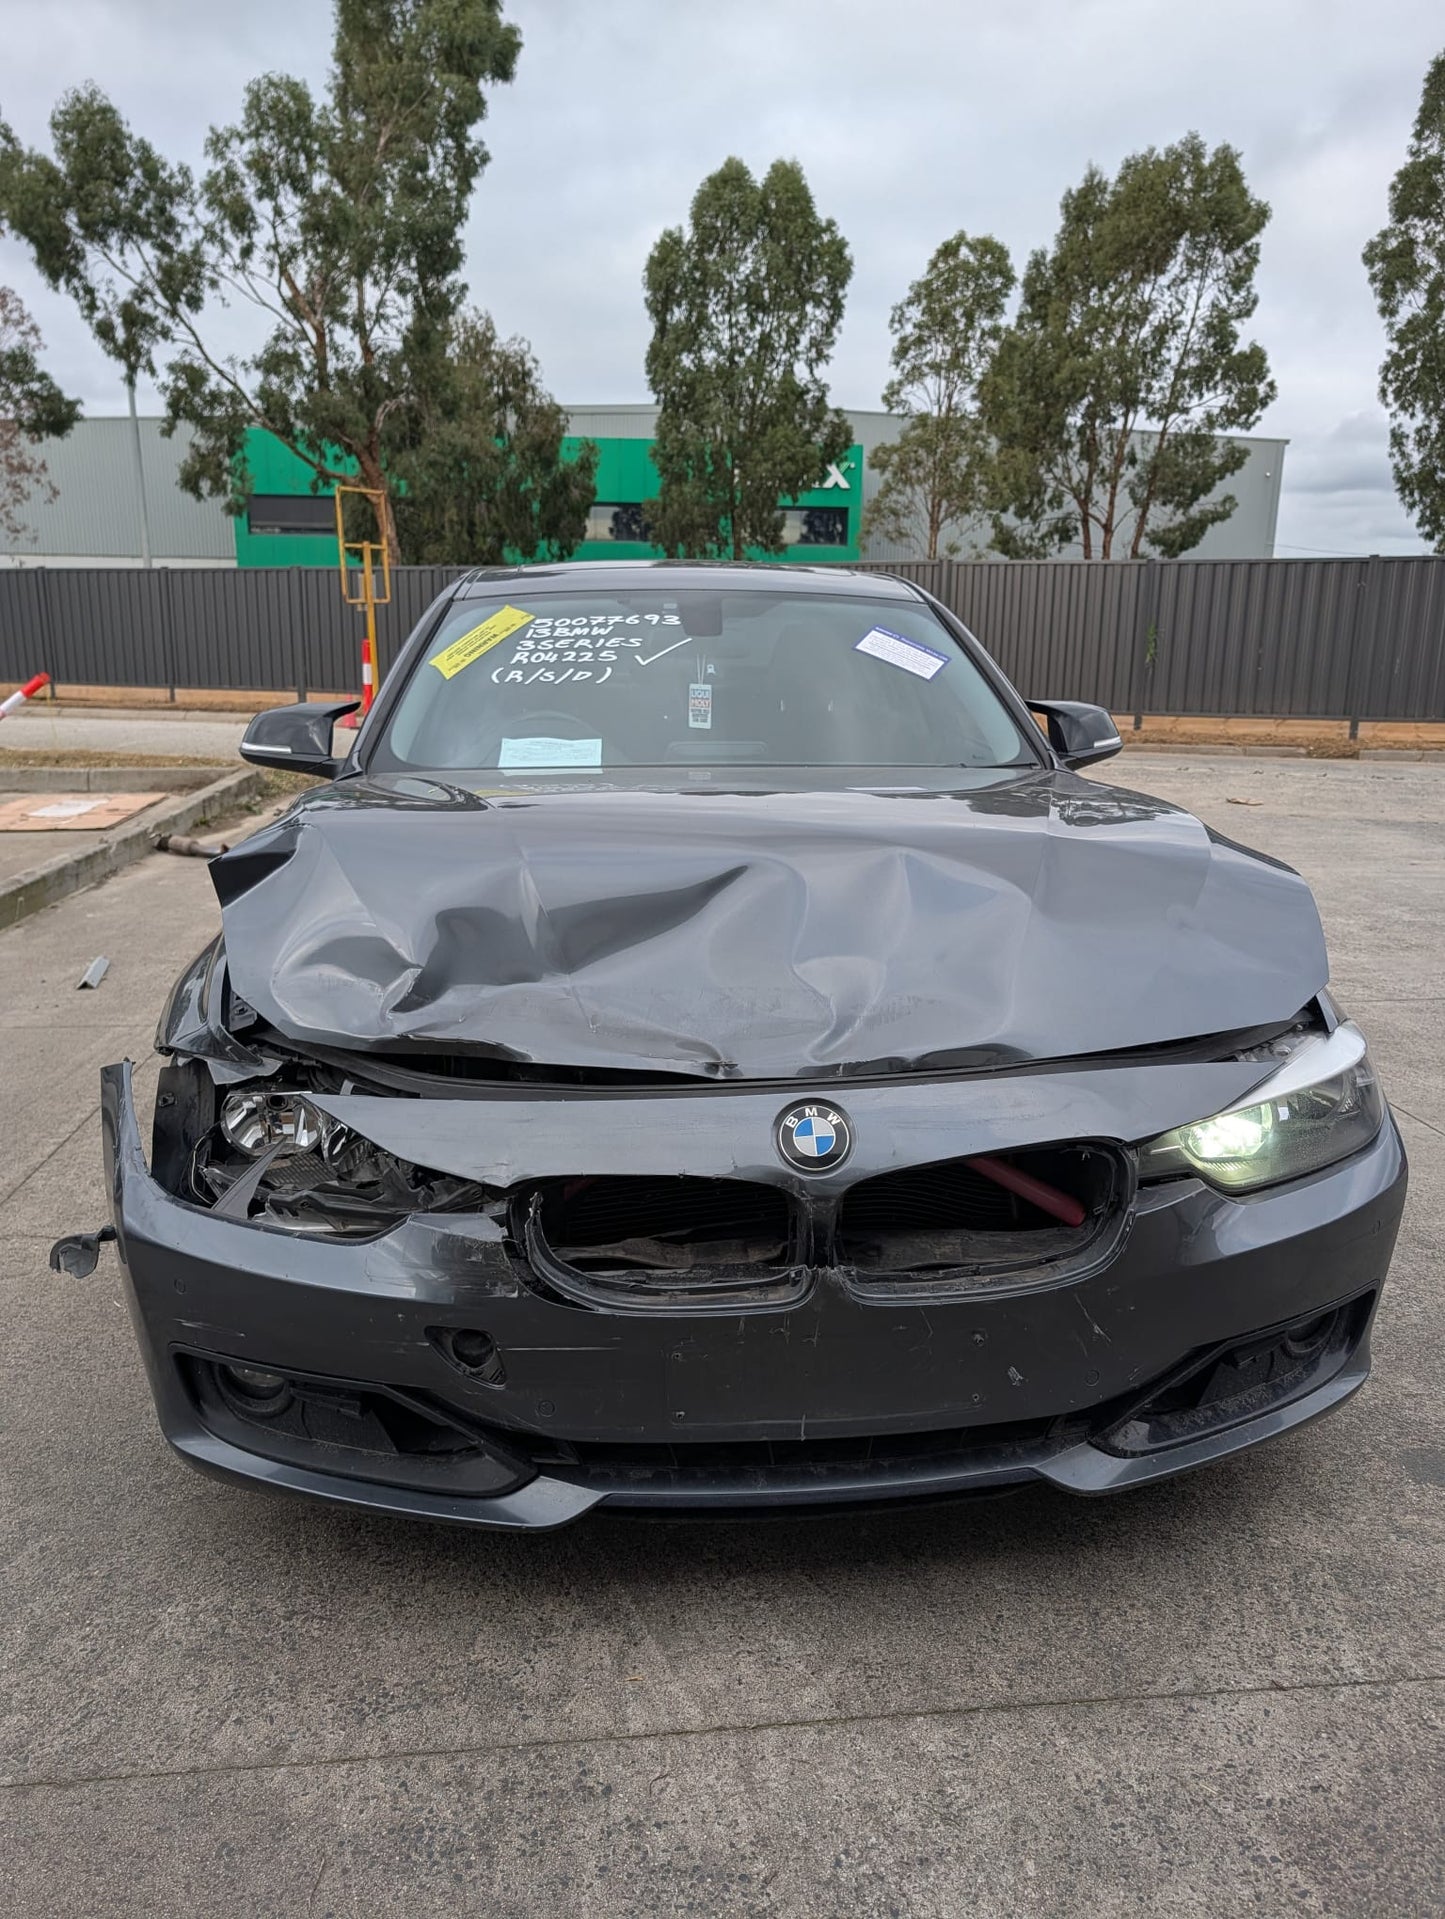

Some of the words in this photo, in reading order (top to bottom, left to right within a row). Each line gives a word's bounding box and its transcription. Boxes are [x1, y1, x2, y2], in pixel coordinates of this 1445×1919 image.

[531, 614, 681, 628] 50077693
[464, 633, 499, 657] WARNING
[785, 1107, 841, 1128] BMW
